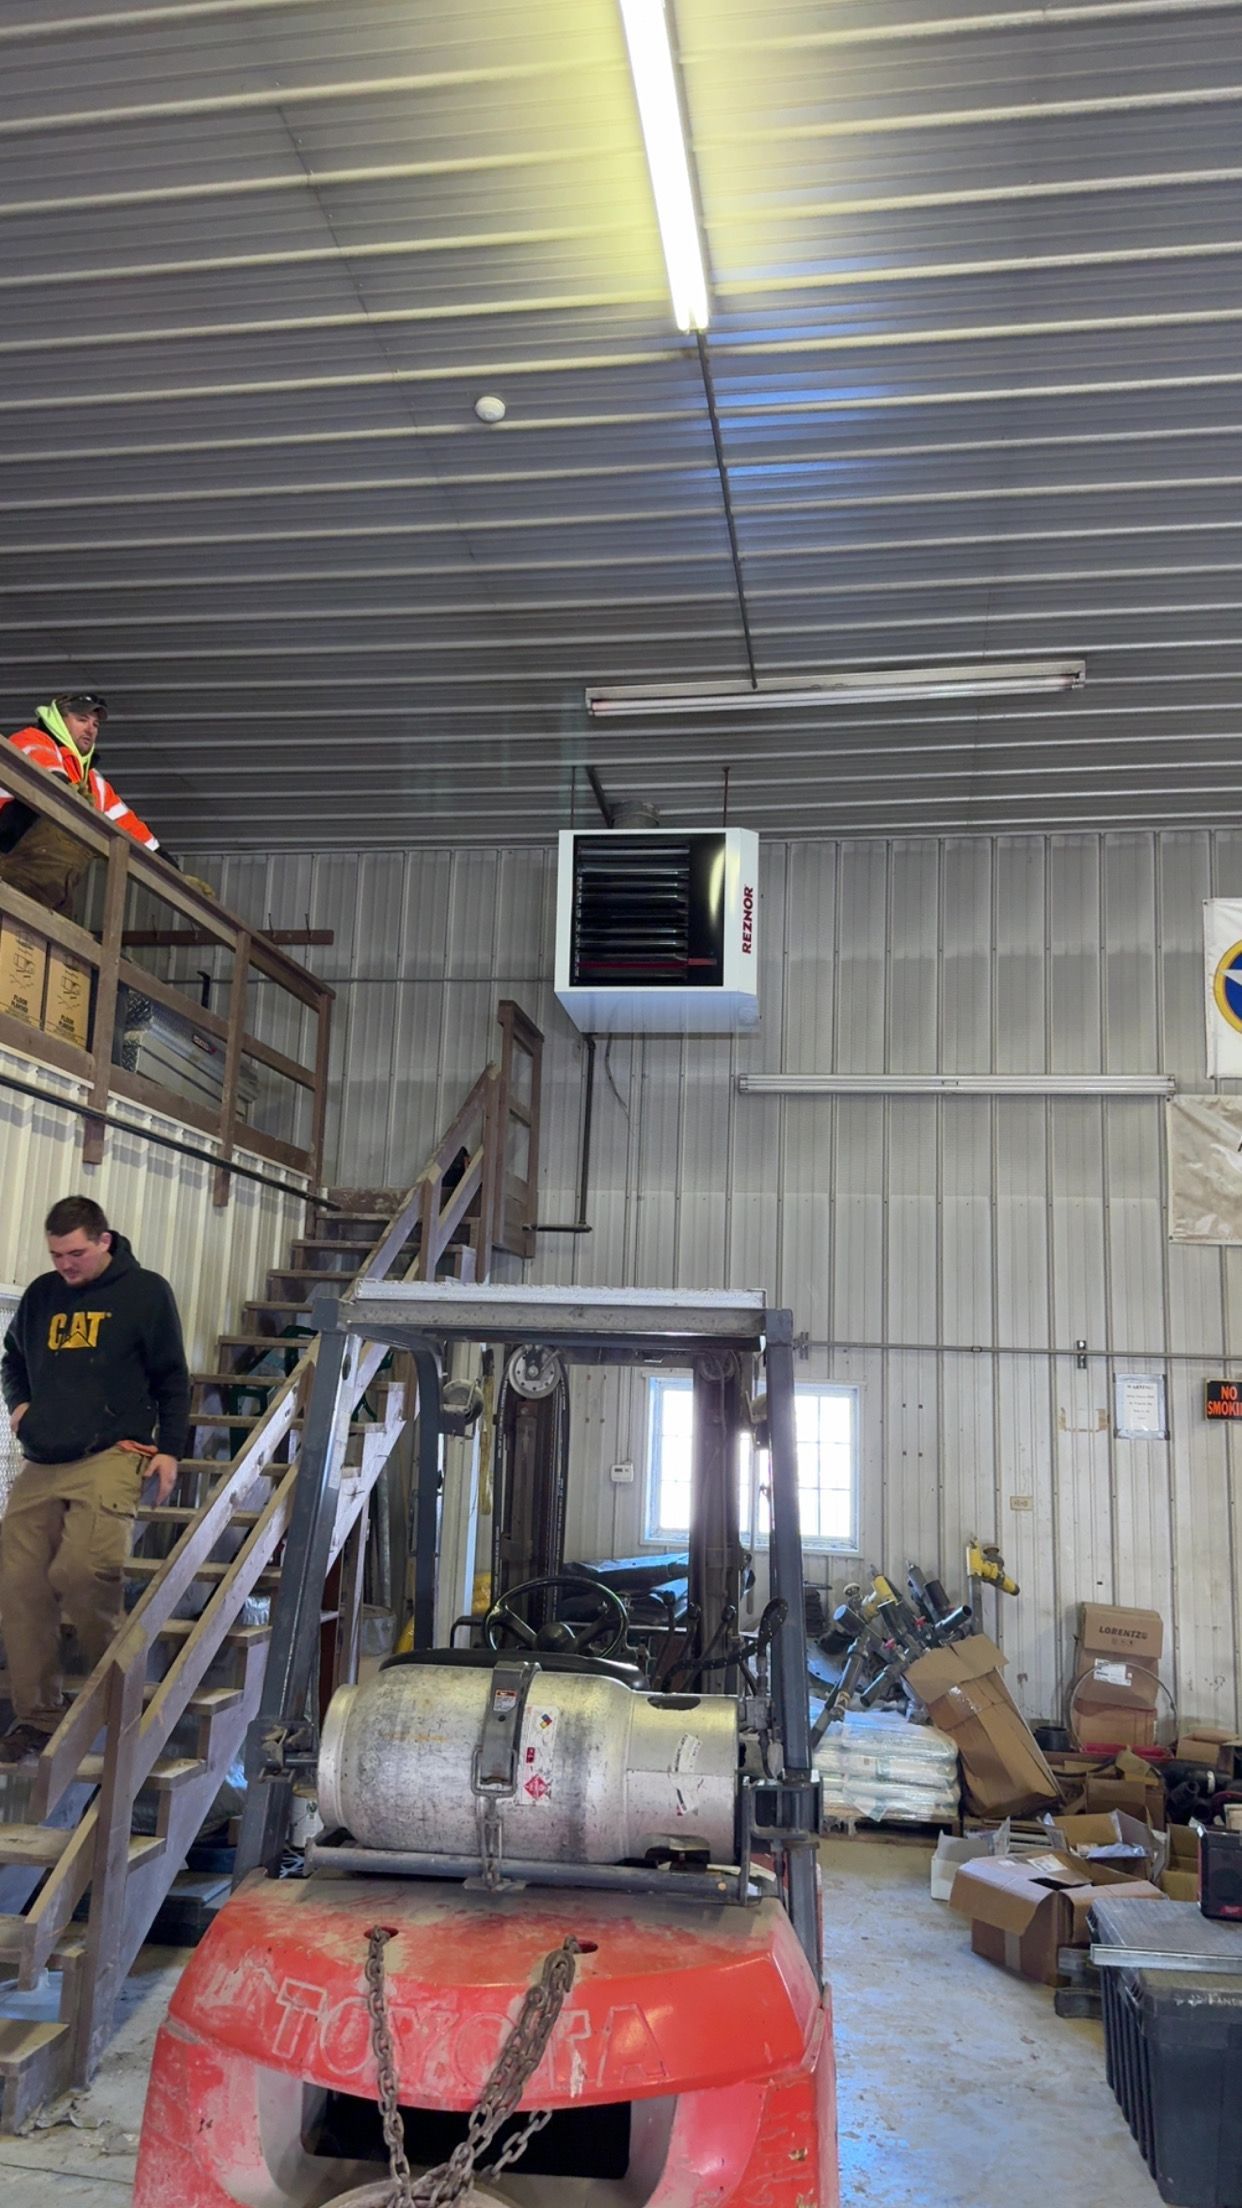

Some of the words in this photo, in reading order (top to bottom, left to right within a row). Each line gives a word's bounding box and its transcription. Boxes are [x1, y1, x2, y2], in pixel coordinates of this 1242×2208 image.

[742, 886, 754, 954] REZNOR
[48, 1311, 106, 1350] CAT
[1221, 1386, 1238, 1400] NO
[1099, 1625, 1143, 1640] LORENTZ
